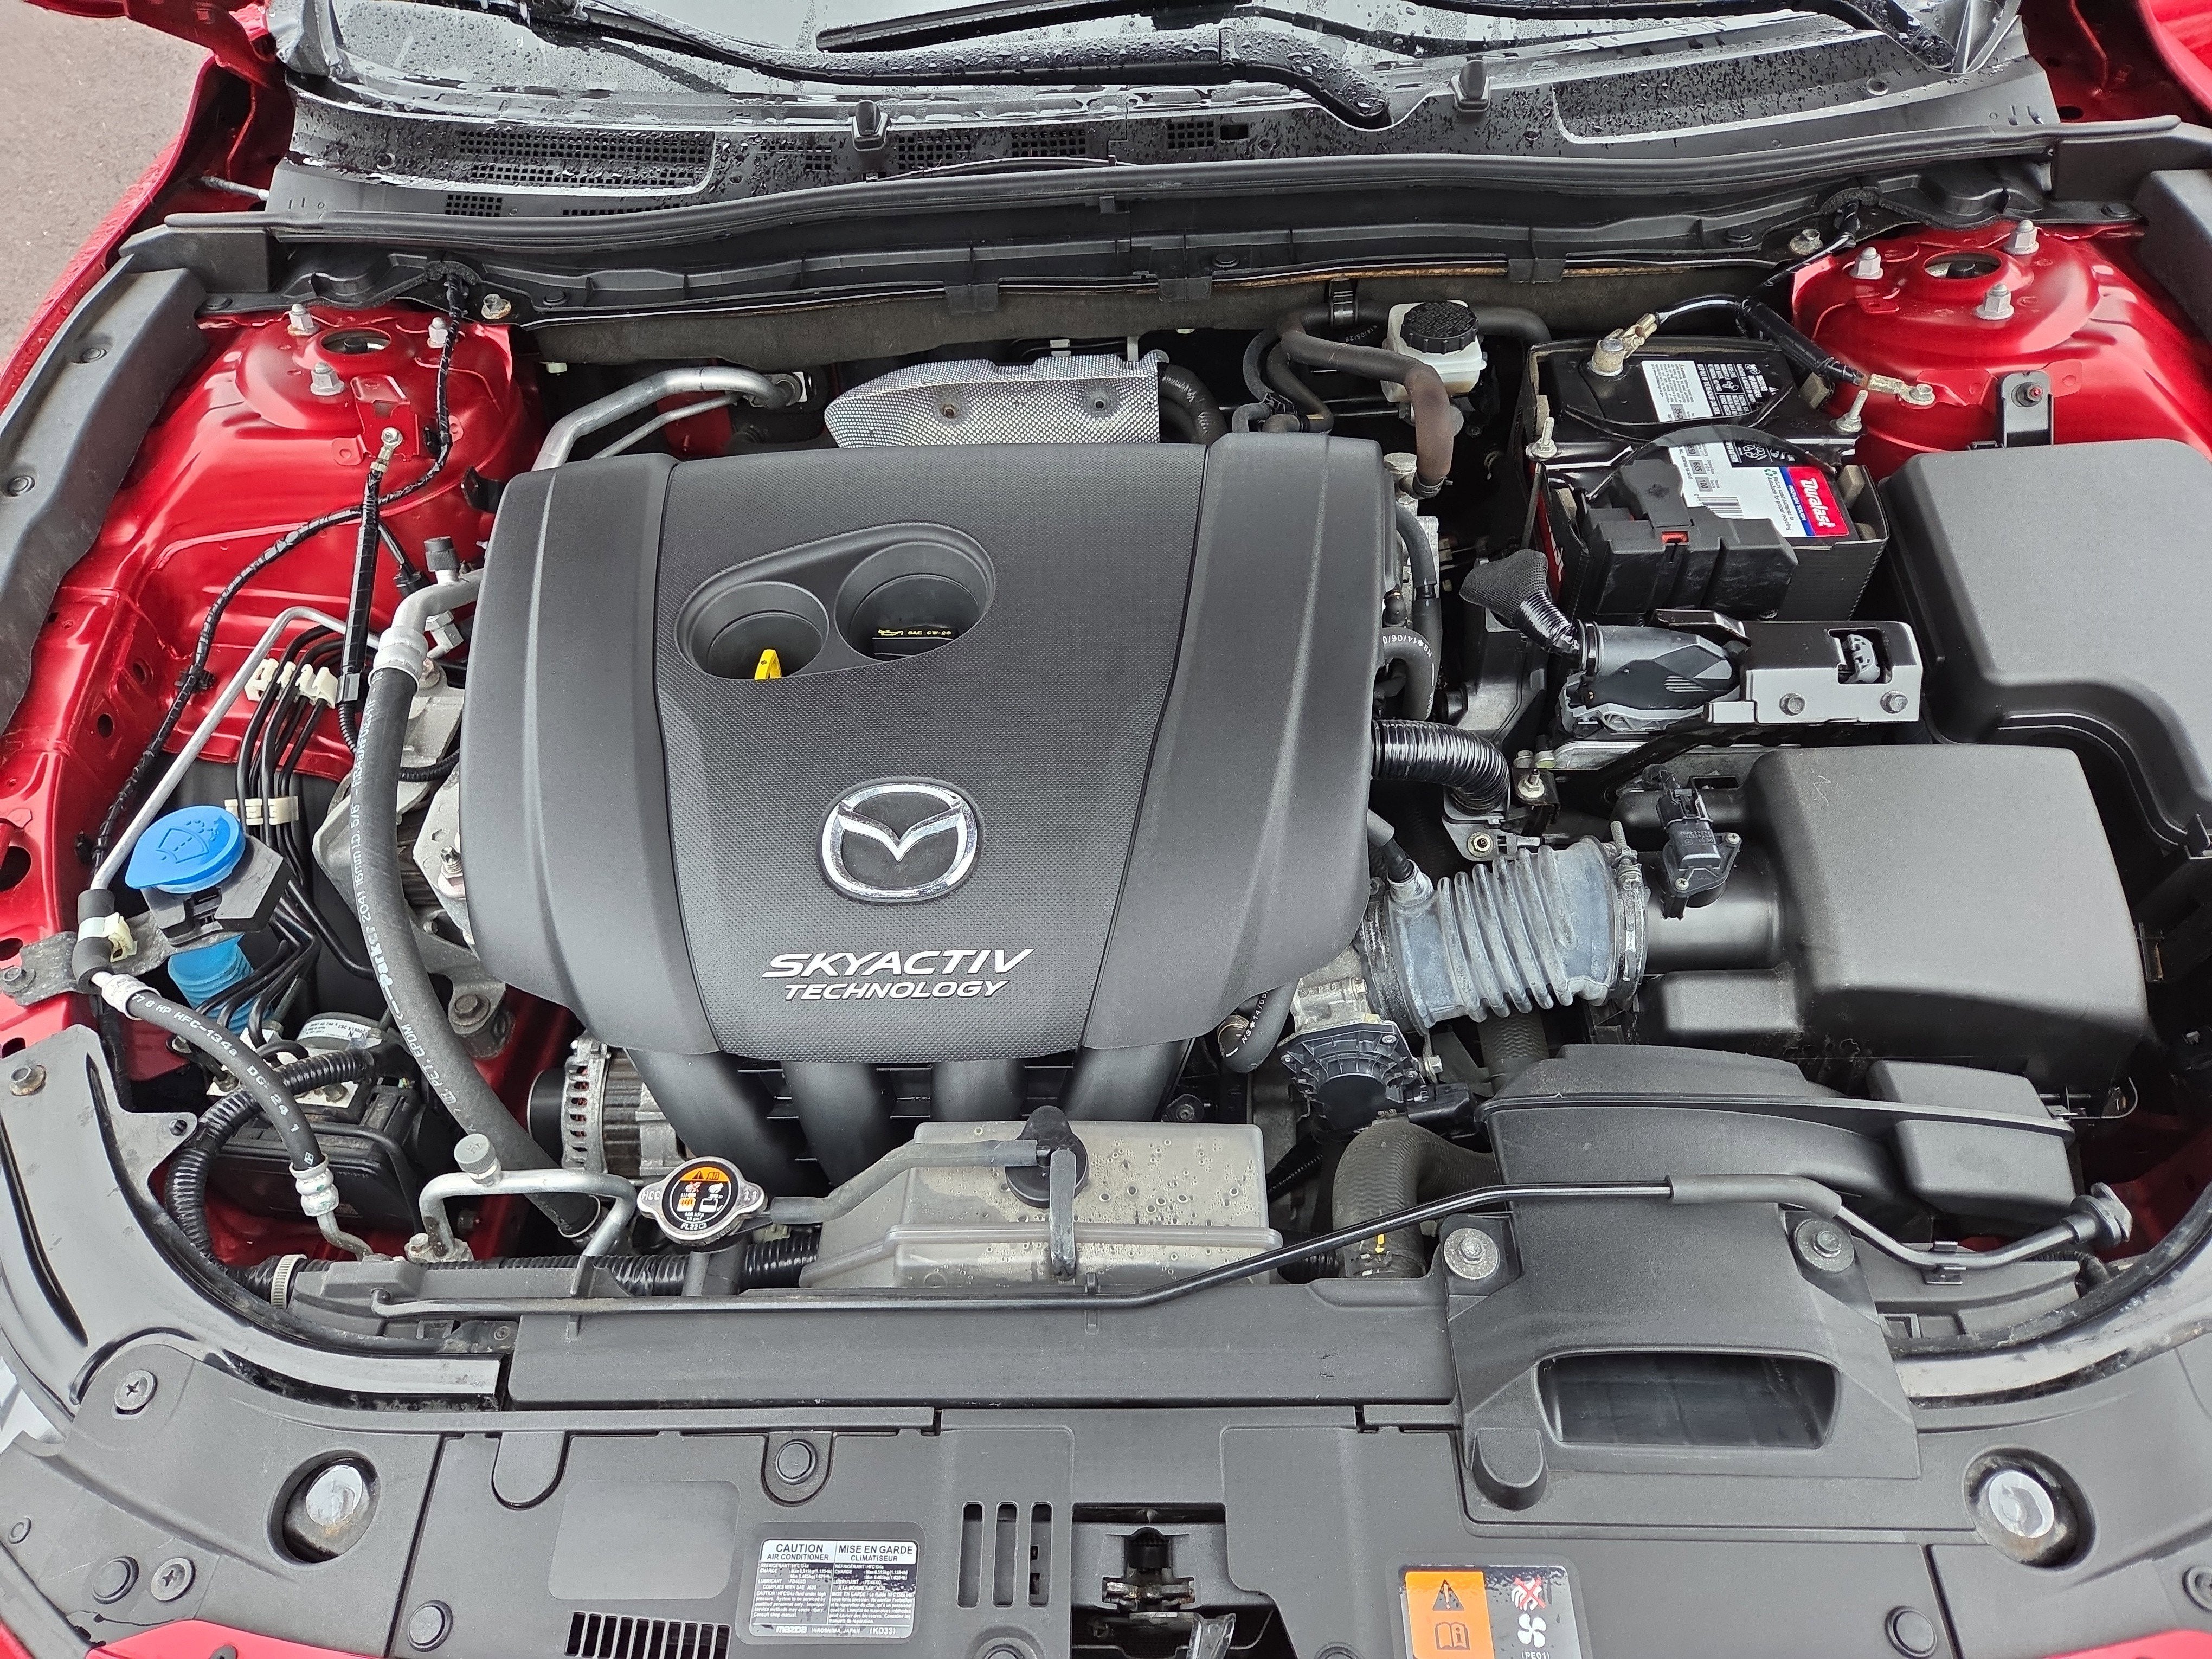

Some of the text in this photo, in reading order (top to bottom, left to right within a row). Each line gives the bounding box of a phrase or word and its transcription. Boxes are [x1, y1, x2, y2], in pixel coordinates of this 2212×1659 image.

[1699, 479, 1708, 489] 100
[1800, 477, 1836, 530] Duralast
[352, 851, 364, 888] 16mm
[357, 890, 371, 923] 2041
[364, 924, 394, 987] Parker
[761, 948, 1035, 979] SKYACTIV
[785, 980, 1011, 1001] TECHNOLOGY
[155, 1004, 172, 1015] HP
[172, 1011, 238, 1057] HFC-134a
[403, 1032, 431, 1065] EPDM
[776, 1544, 823, 1553] CAUTION
[839, 1545, 861, 1553] MISE
[879, 1546, 912, 1554] GARDE
